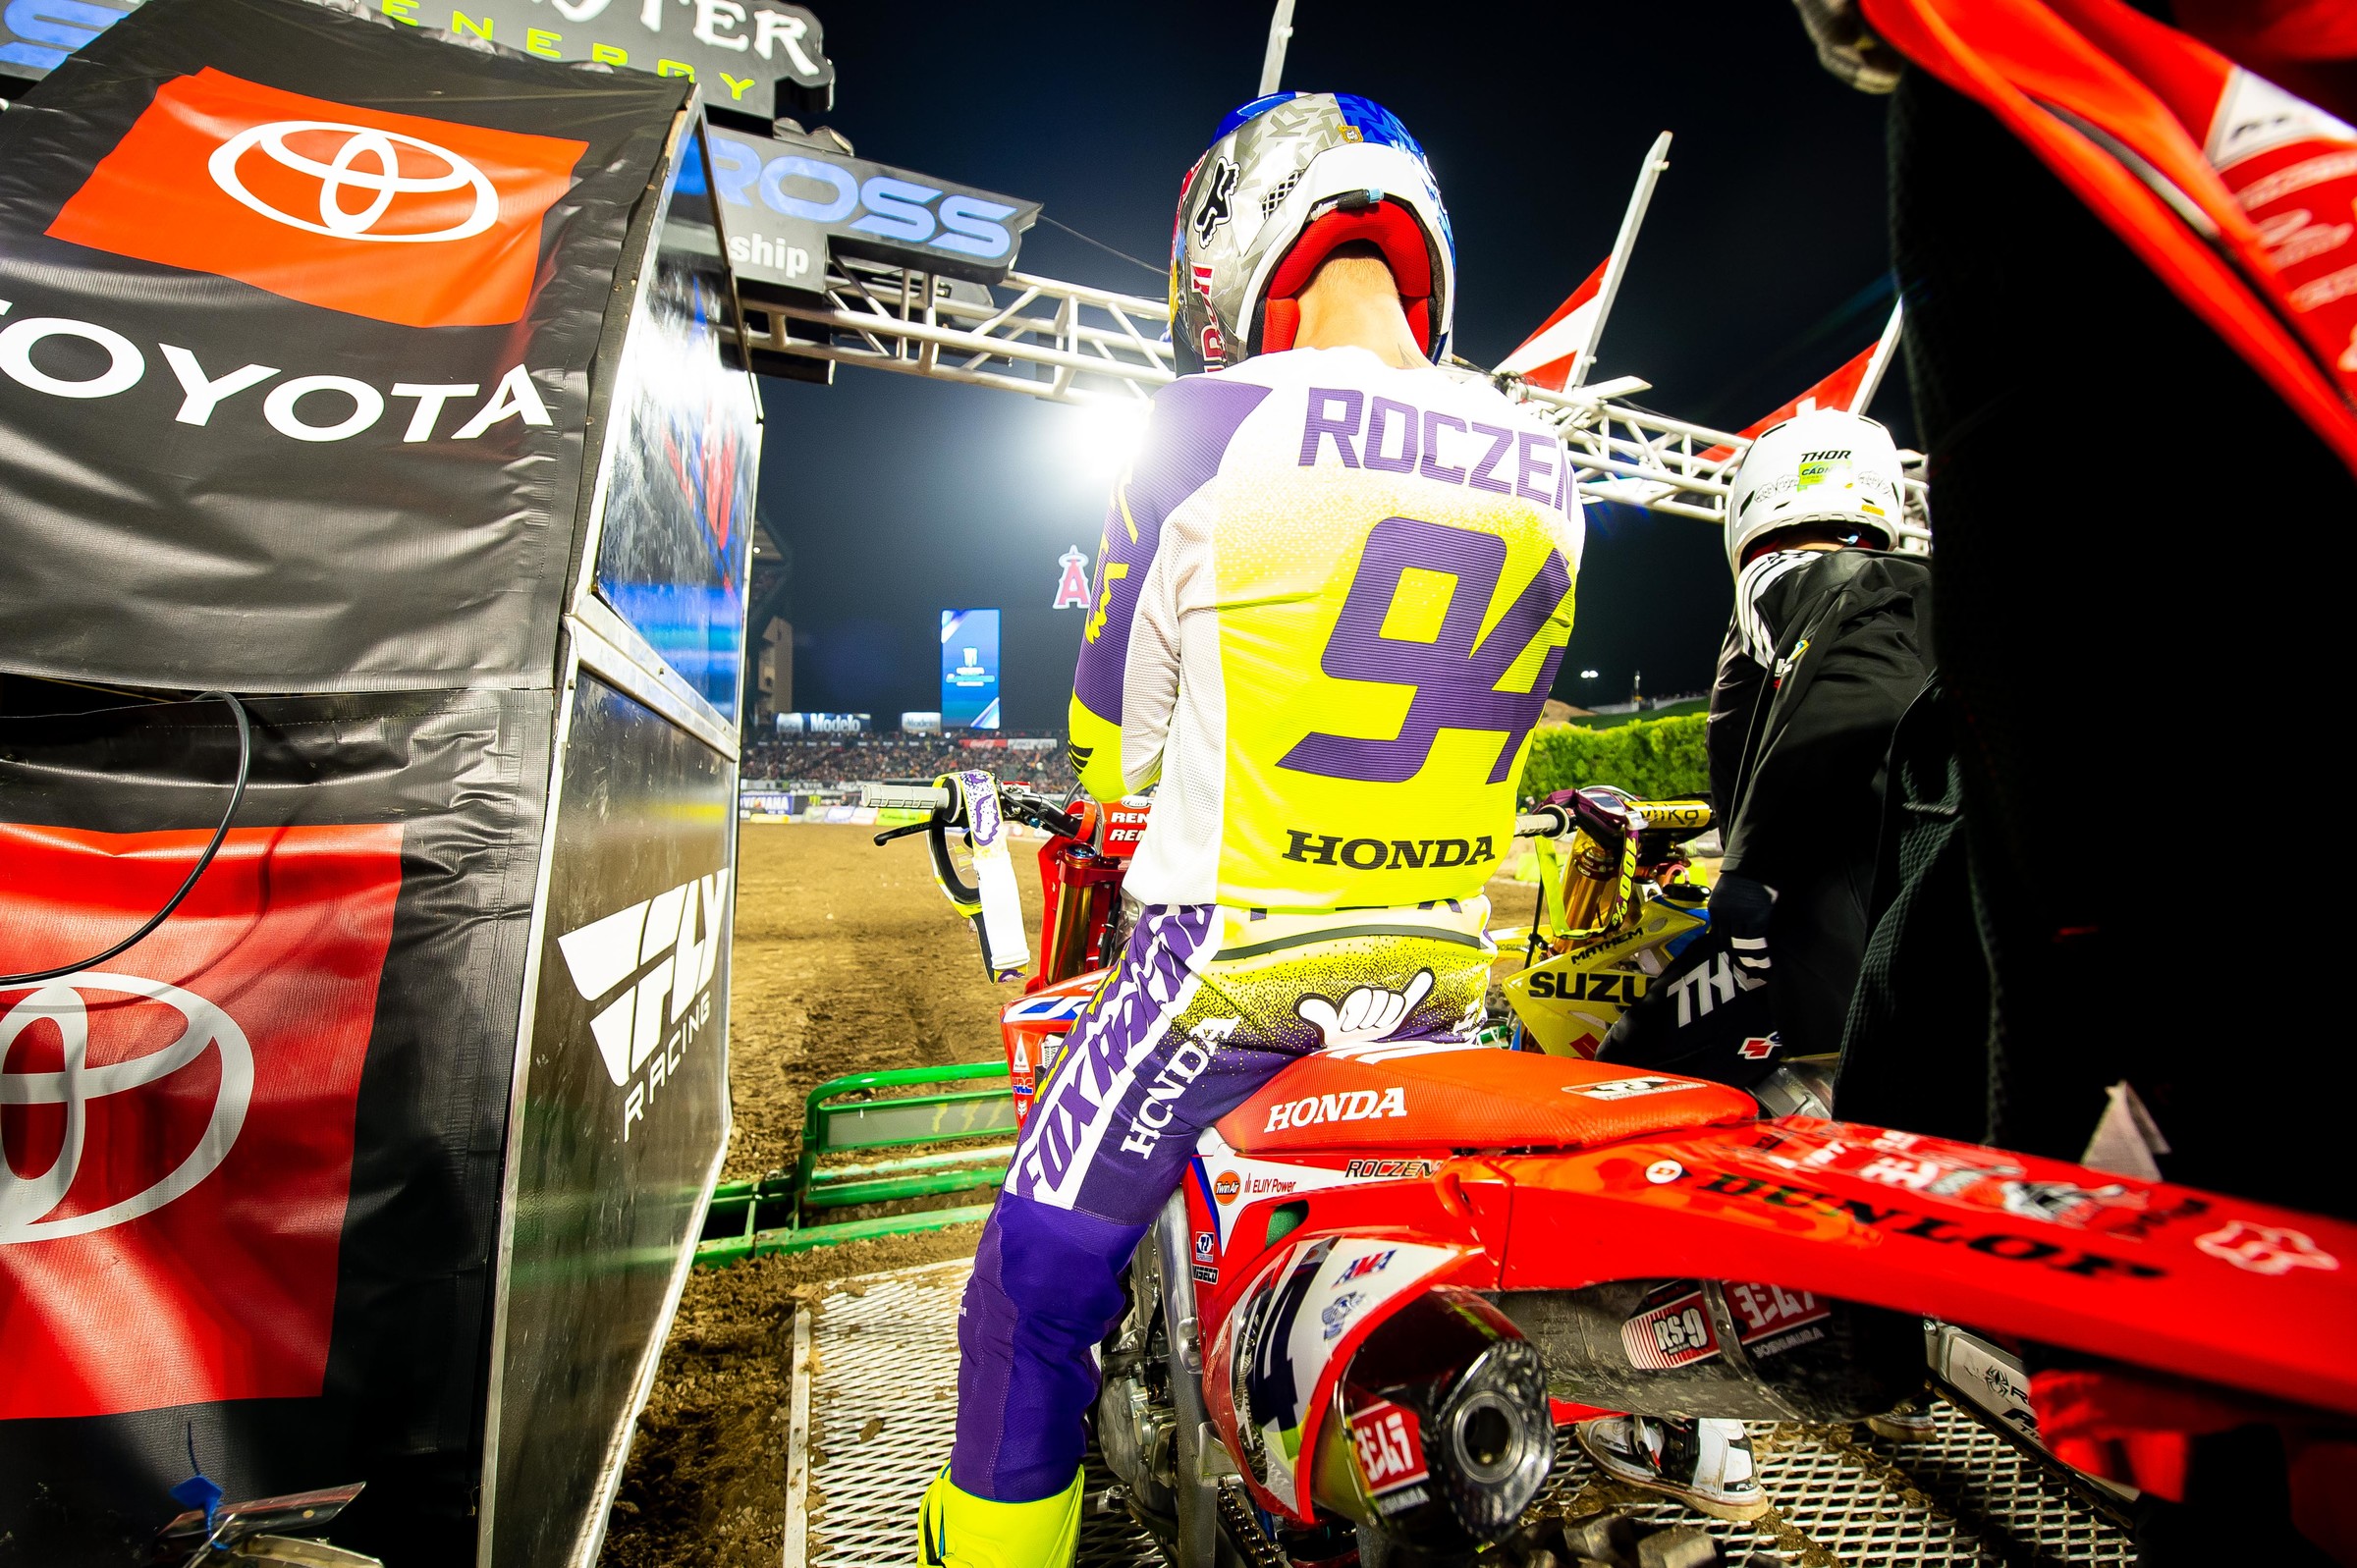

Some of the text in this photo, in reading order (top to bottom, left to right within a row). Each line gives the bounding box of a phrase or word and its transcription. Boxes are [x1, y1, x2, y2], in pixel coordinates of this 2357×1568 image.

[0, 300, 553, 443] OYOTA
[1298, 388, 1571, 522] ROCZEN
[1801, 450, 1851, 462] THOR
[1275, 516, 1570, 784] 94
[810, 713, 860, 732] Modelo
[1282, 830, 1495, 870] HONDA
[1570, 927, 1644, 964] MAYHEM
[624, 990, 711, 1143] RACING
[1121, 1015, 1241, 1161] HONDA
[1264, 1087, 1407, 1133] HONDA
[1272, 1178, 1297, 1193] Power
[1697, 1173, 2167, 1276] DUNLOP
